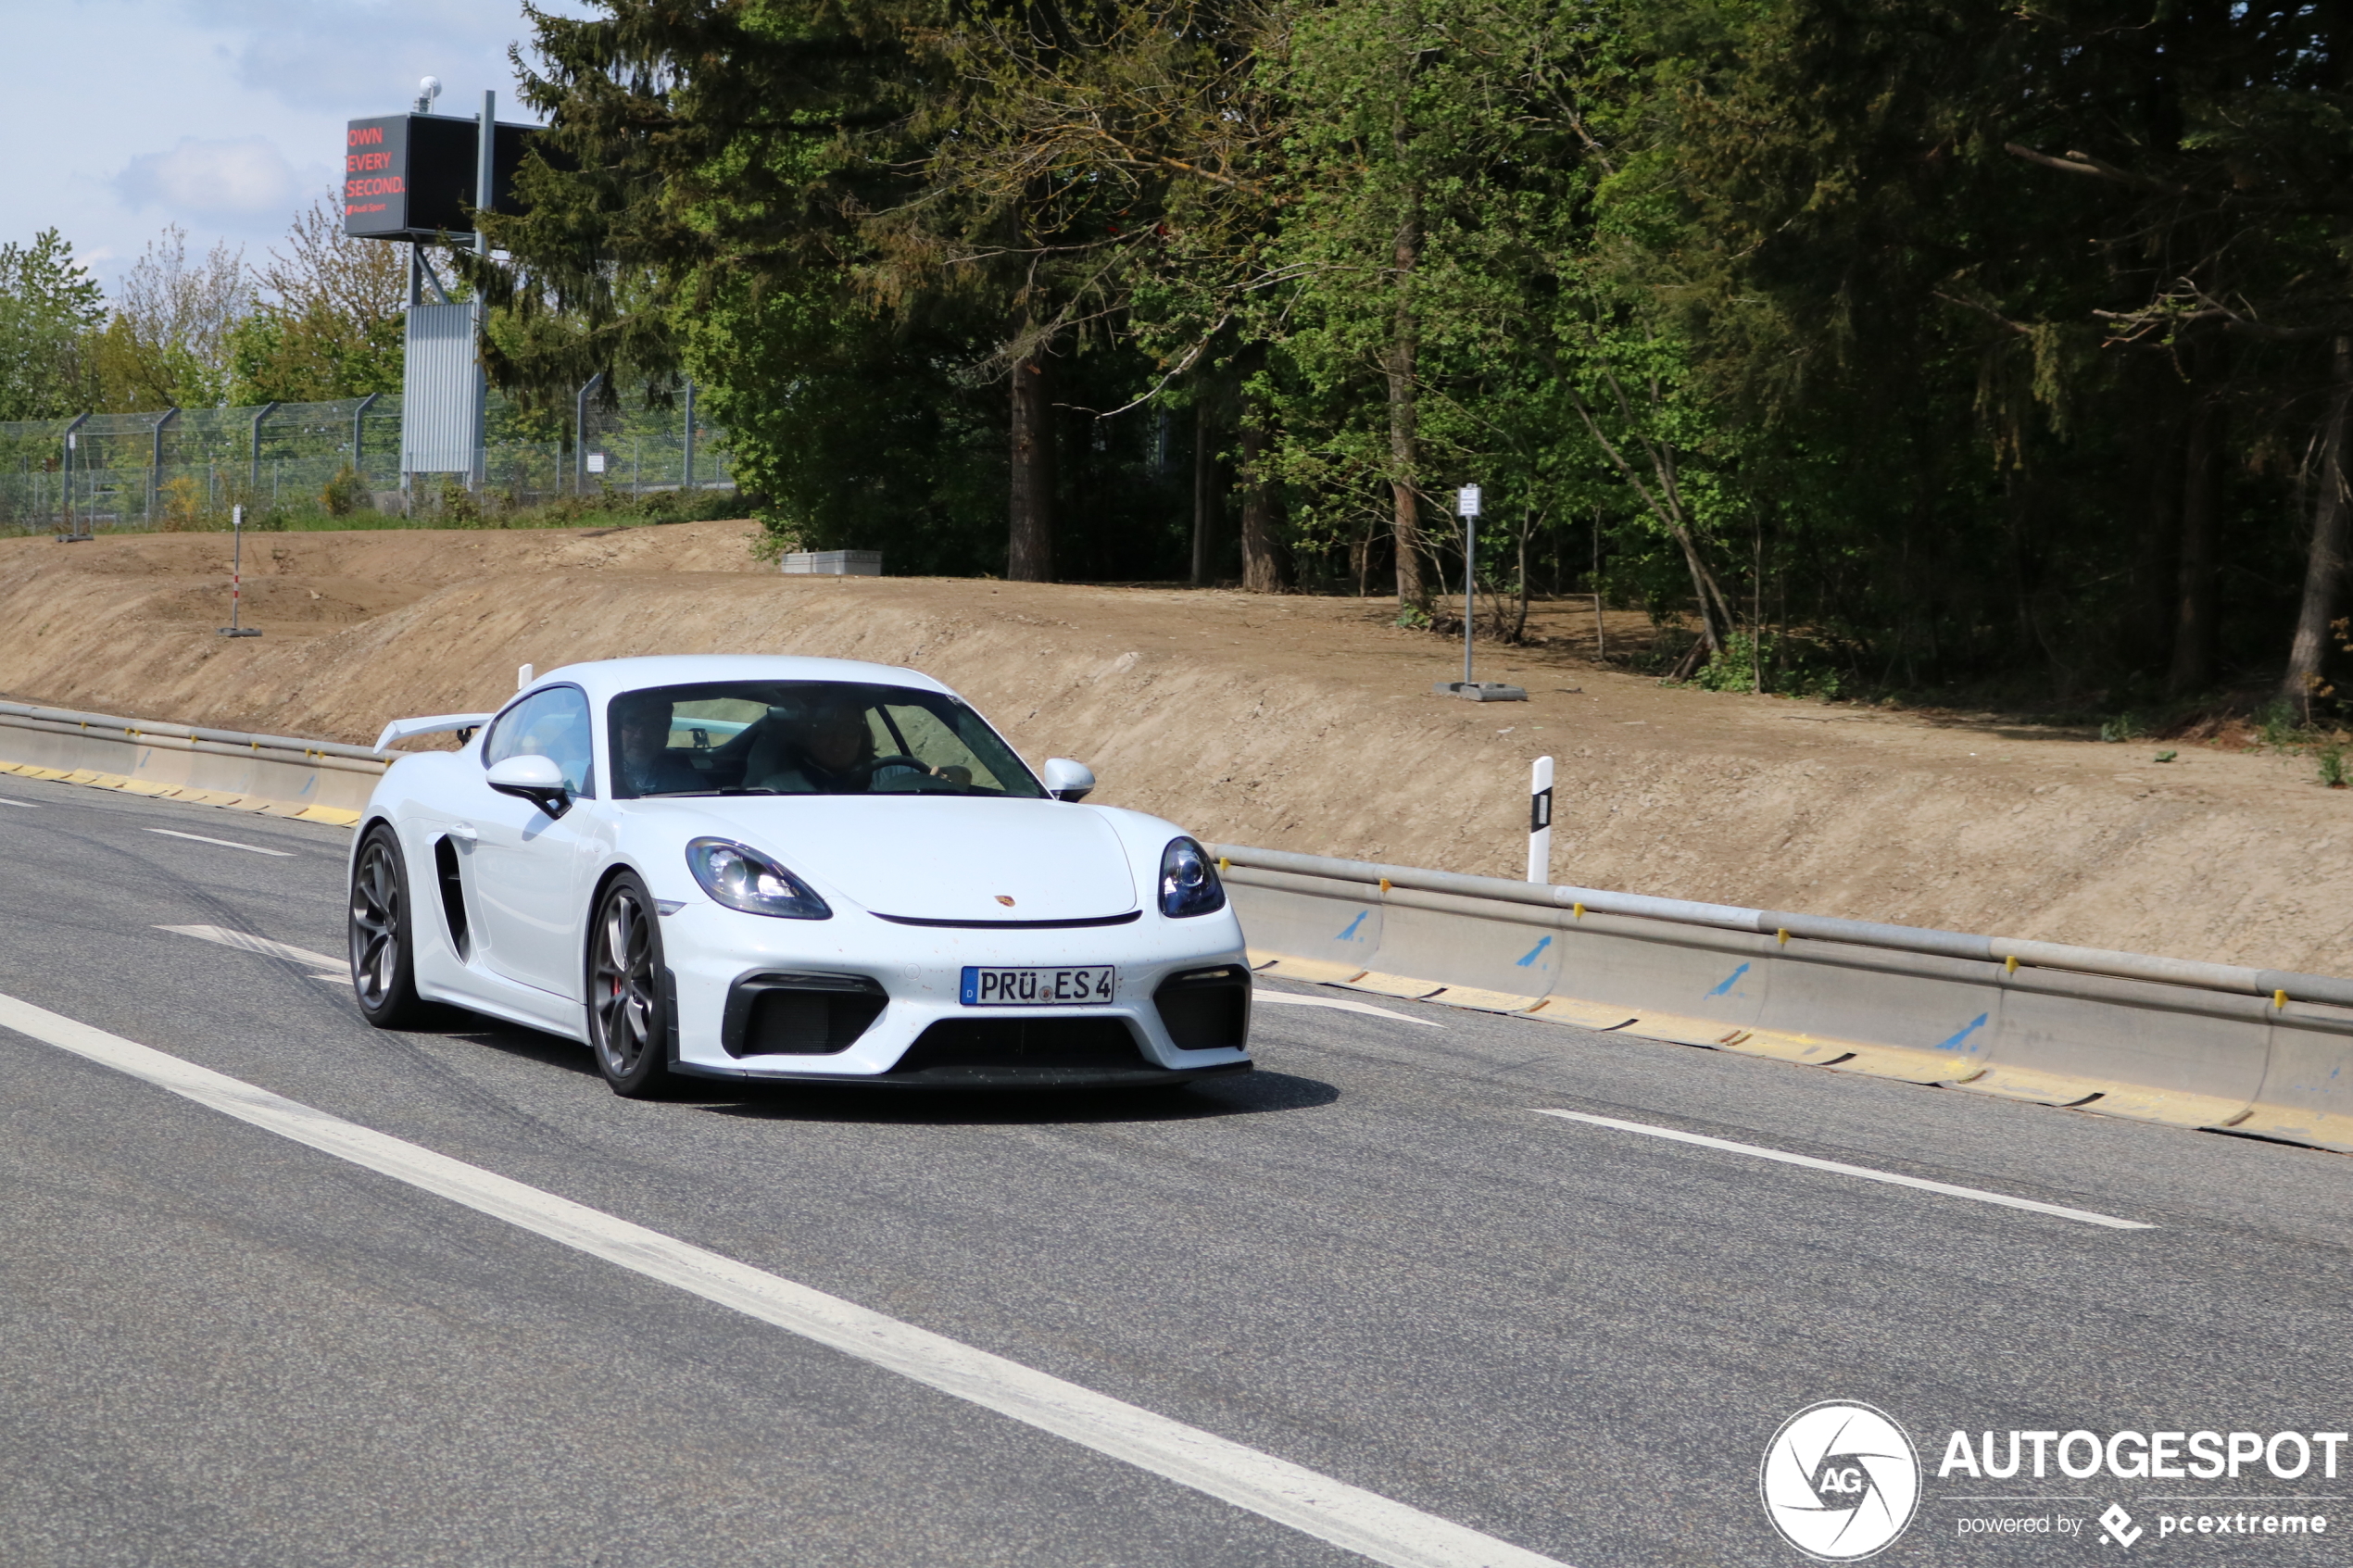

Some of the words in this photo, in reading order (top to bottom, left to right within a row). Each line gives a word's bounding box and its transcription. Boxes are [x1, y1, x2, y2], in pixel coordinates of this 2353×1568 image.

[347, 127, 383, 146] OWN
[346, 152, 391, 172] EVERY
[346, 176, 407, 197] SECOND.
[352, 205, 368, 213] Audi
[369, 203, 386, 213] Sport
[966, 990, 973, 998] D
